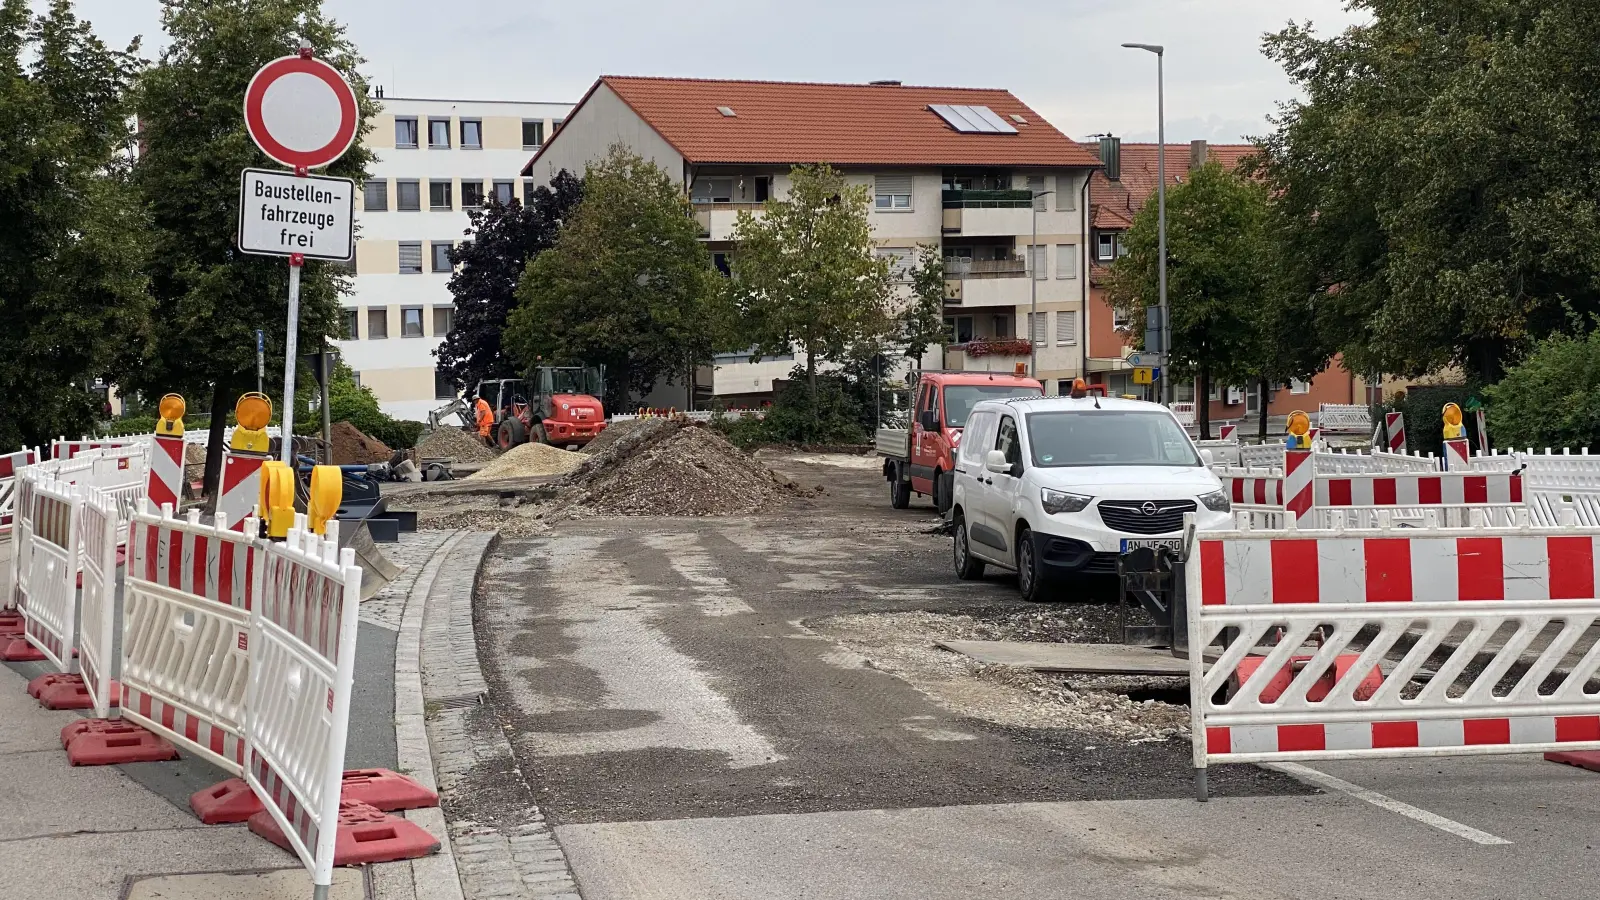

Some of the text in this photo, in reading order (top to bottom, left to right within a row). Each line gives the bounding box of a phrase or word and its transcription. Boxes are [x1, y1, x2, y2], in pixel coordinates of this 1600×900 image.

[255, 180, 342, 204] Baustellen-
[261, 204, 334, 230] fahrzeuge
[280, 228, 315, 248] frei
